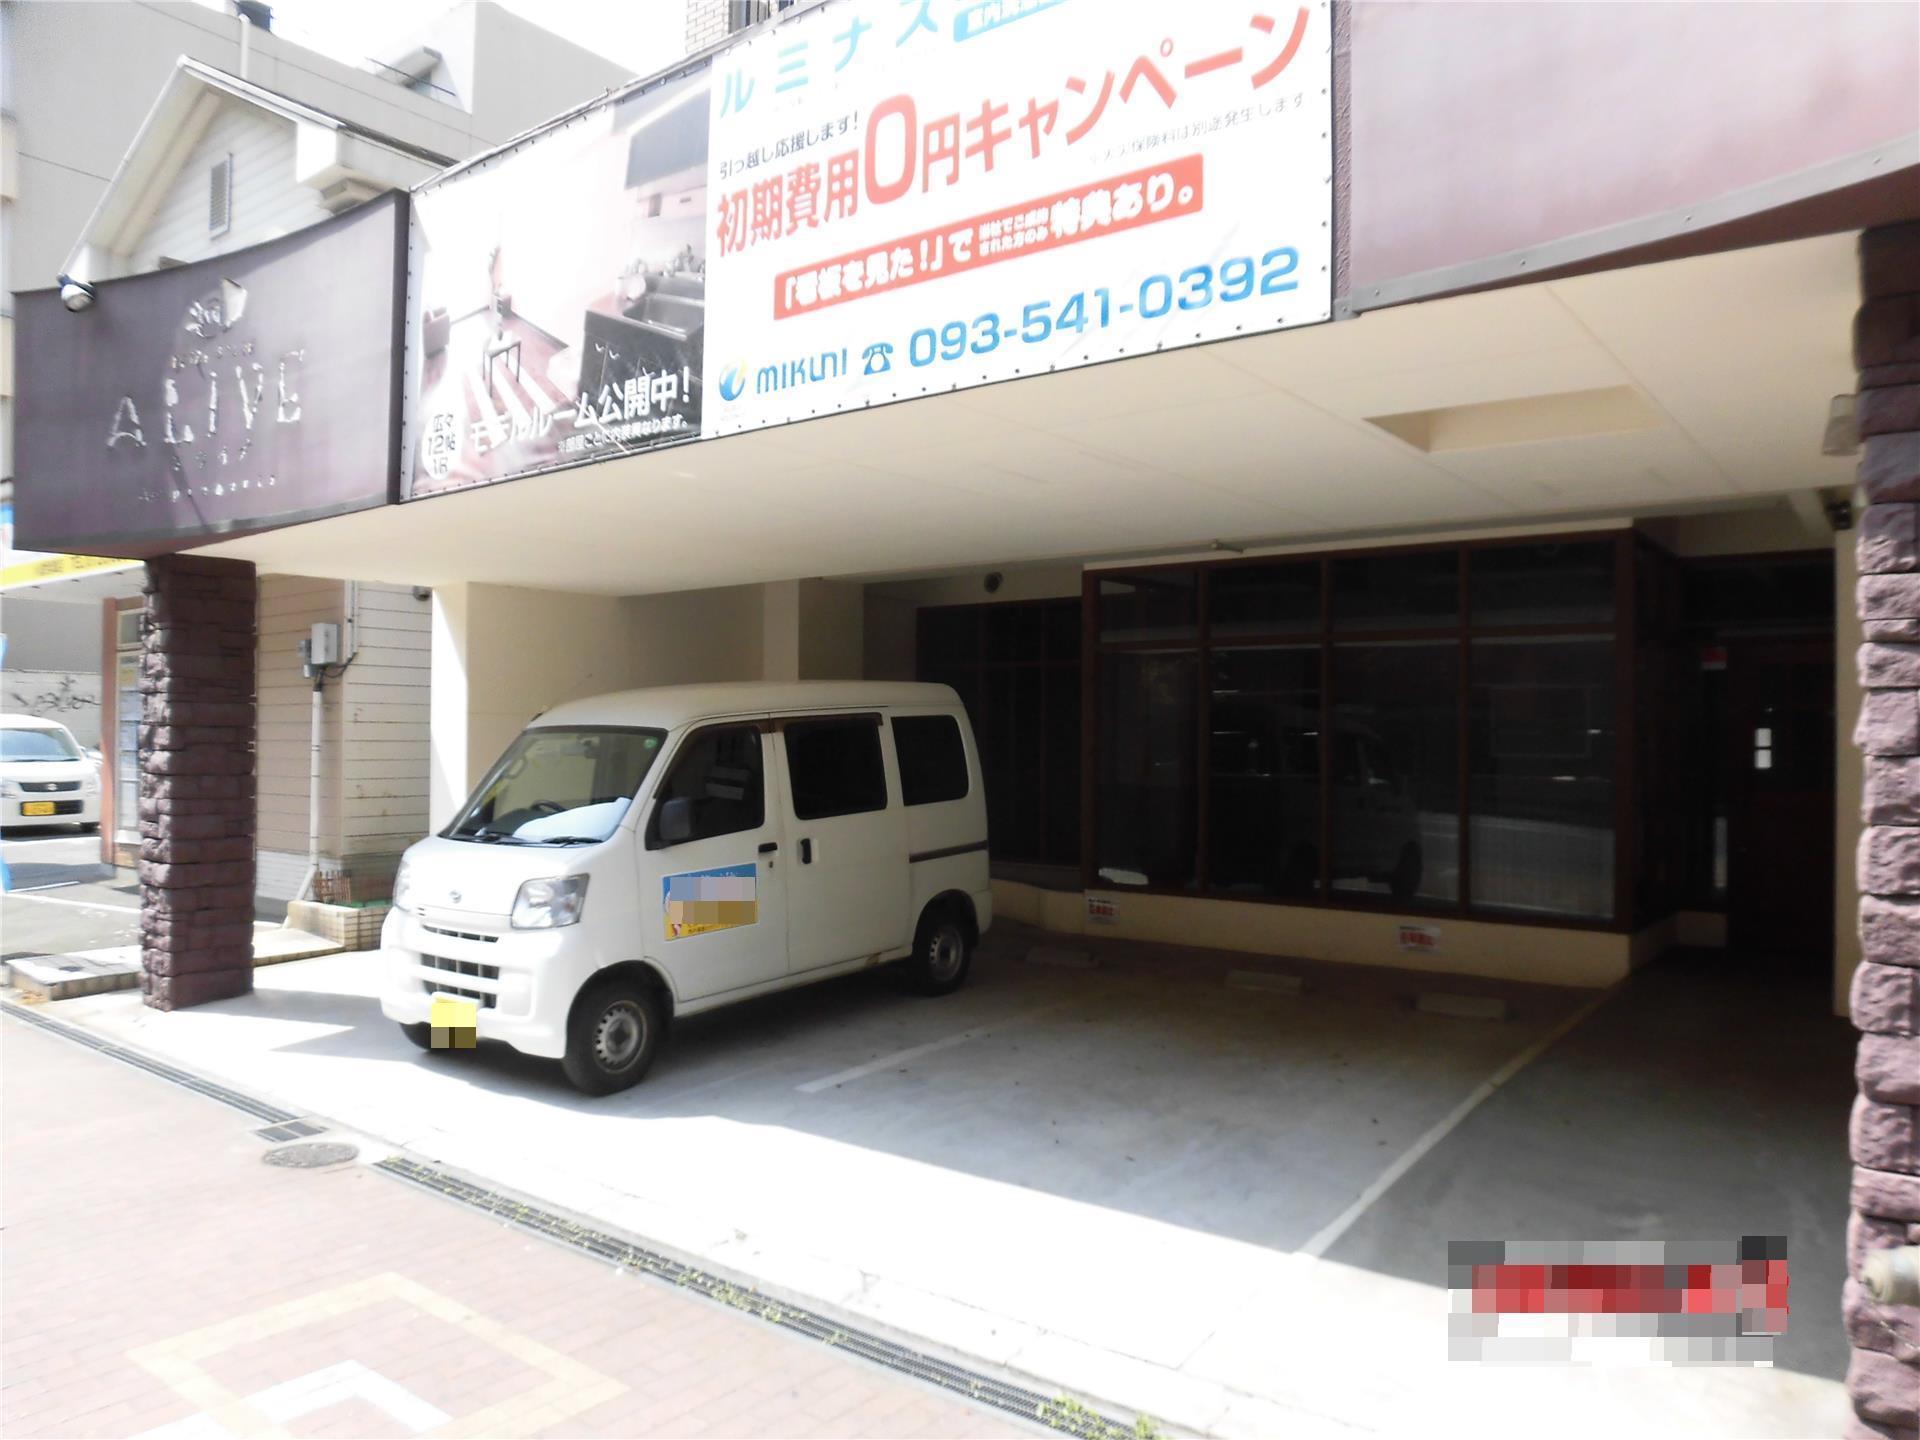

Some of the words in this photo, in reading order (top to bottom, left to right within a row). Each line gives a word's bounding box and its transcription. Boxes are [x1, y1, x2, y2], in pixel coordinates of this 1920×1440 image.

[716, 6, 1310, 258] 初期費用0円キャンペーン
[719, 109, 858, 180] 引っ越し応援します!
[1088, 91, 1304, 164] 保険料は別途発生します
[909, 245, 1300, 367] 093-541-0392
